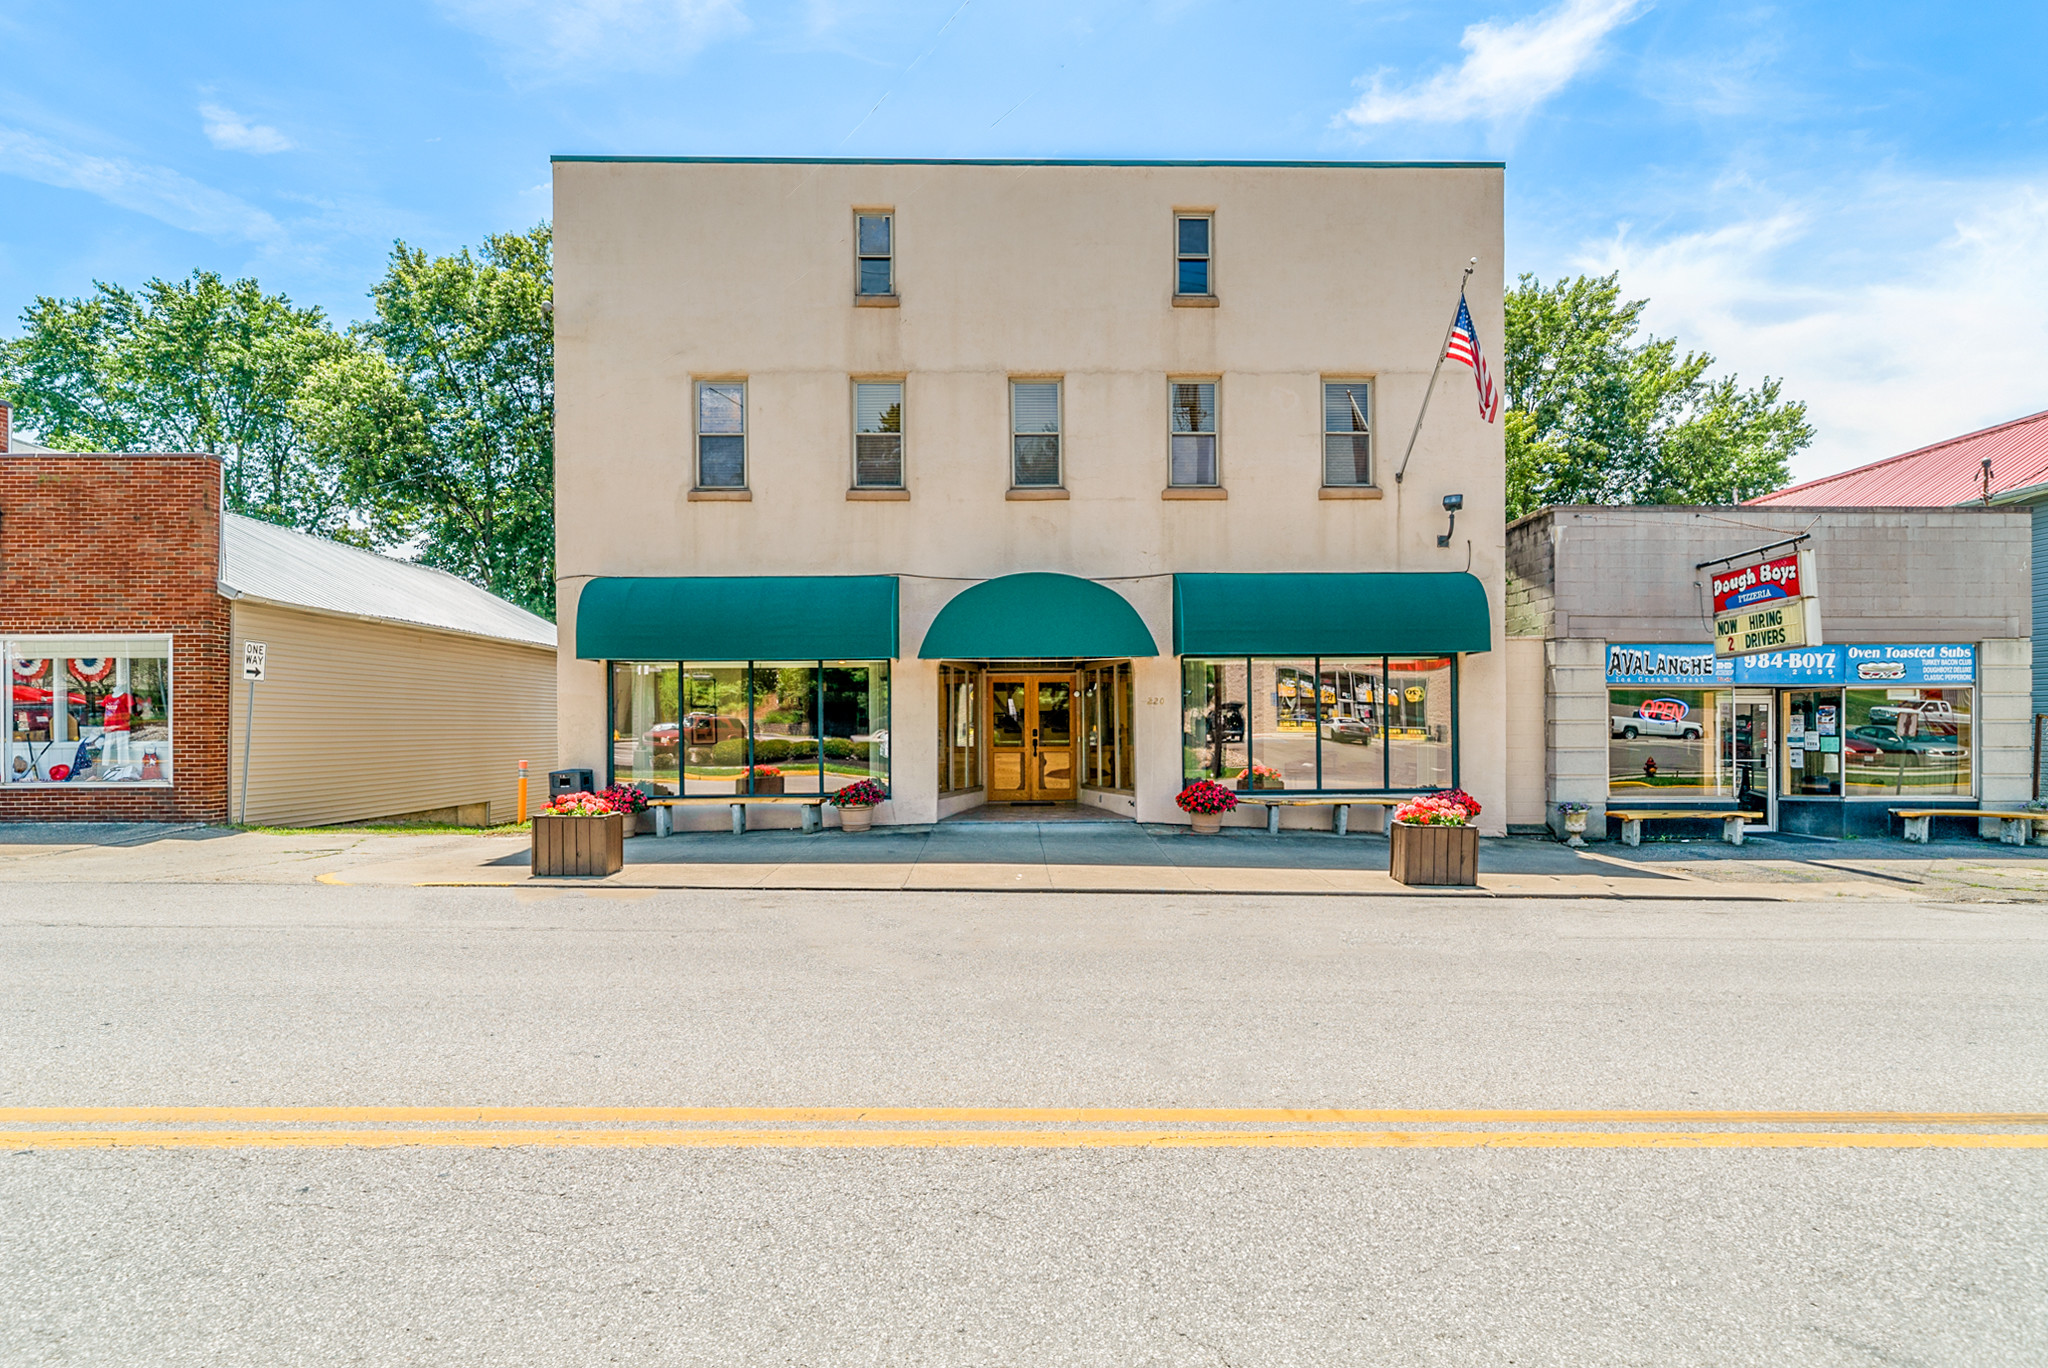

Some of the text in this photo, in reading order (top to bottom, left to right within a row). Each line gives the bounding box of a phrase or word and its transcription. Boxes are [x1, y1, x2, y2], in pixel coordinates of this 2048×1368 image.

[1714, 564, 1797, 597] Dough Boyz
[1738, 589, 1772, 603] PIZZERIA
[1717, 610, 1782, 636] NOW HIRING
[1727, 628, 1786, 652] 2 DRIVERS
[247, 644, 263, 655] ONE
[1848, 646, 1972, 659] Oven Toasted Subs
[246, 655, 263, 665] WAY
[1607, 645, 1714, 677] AVALANCHE
[1744, 652, 1836, 669] 984-BOYZ
[1922, 666, 1973, 674] DOUGHBOYZ DELUXE
[1146, 696, 1165, 705] 220
[1640, 699, 1685, 722] OPEN
